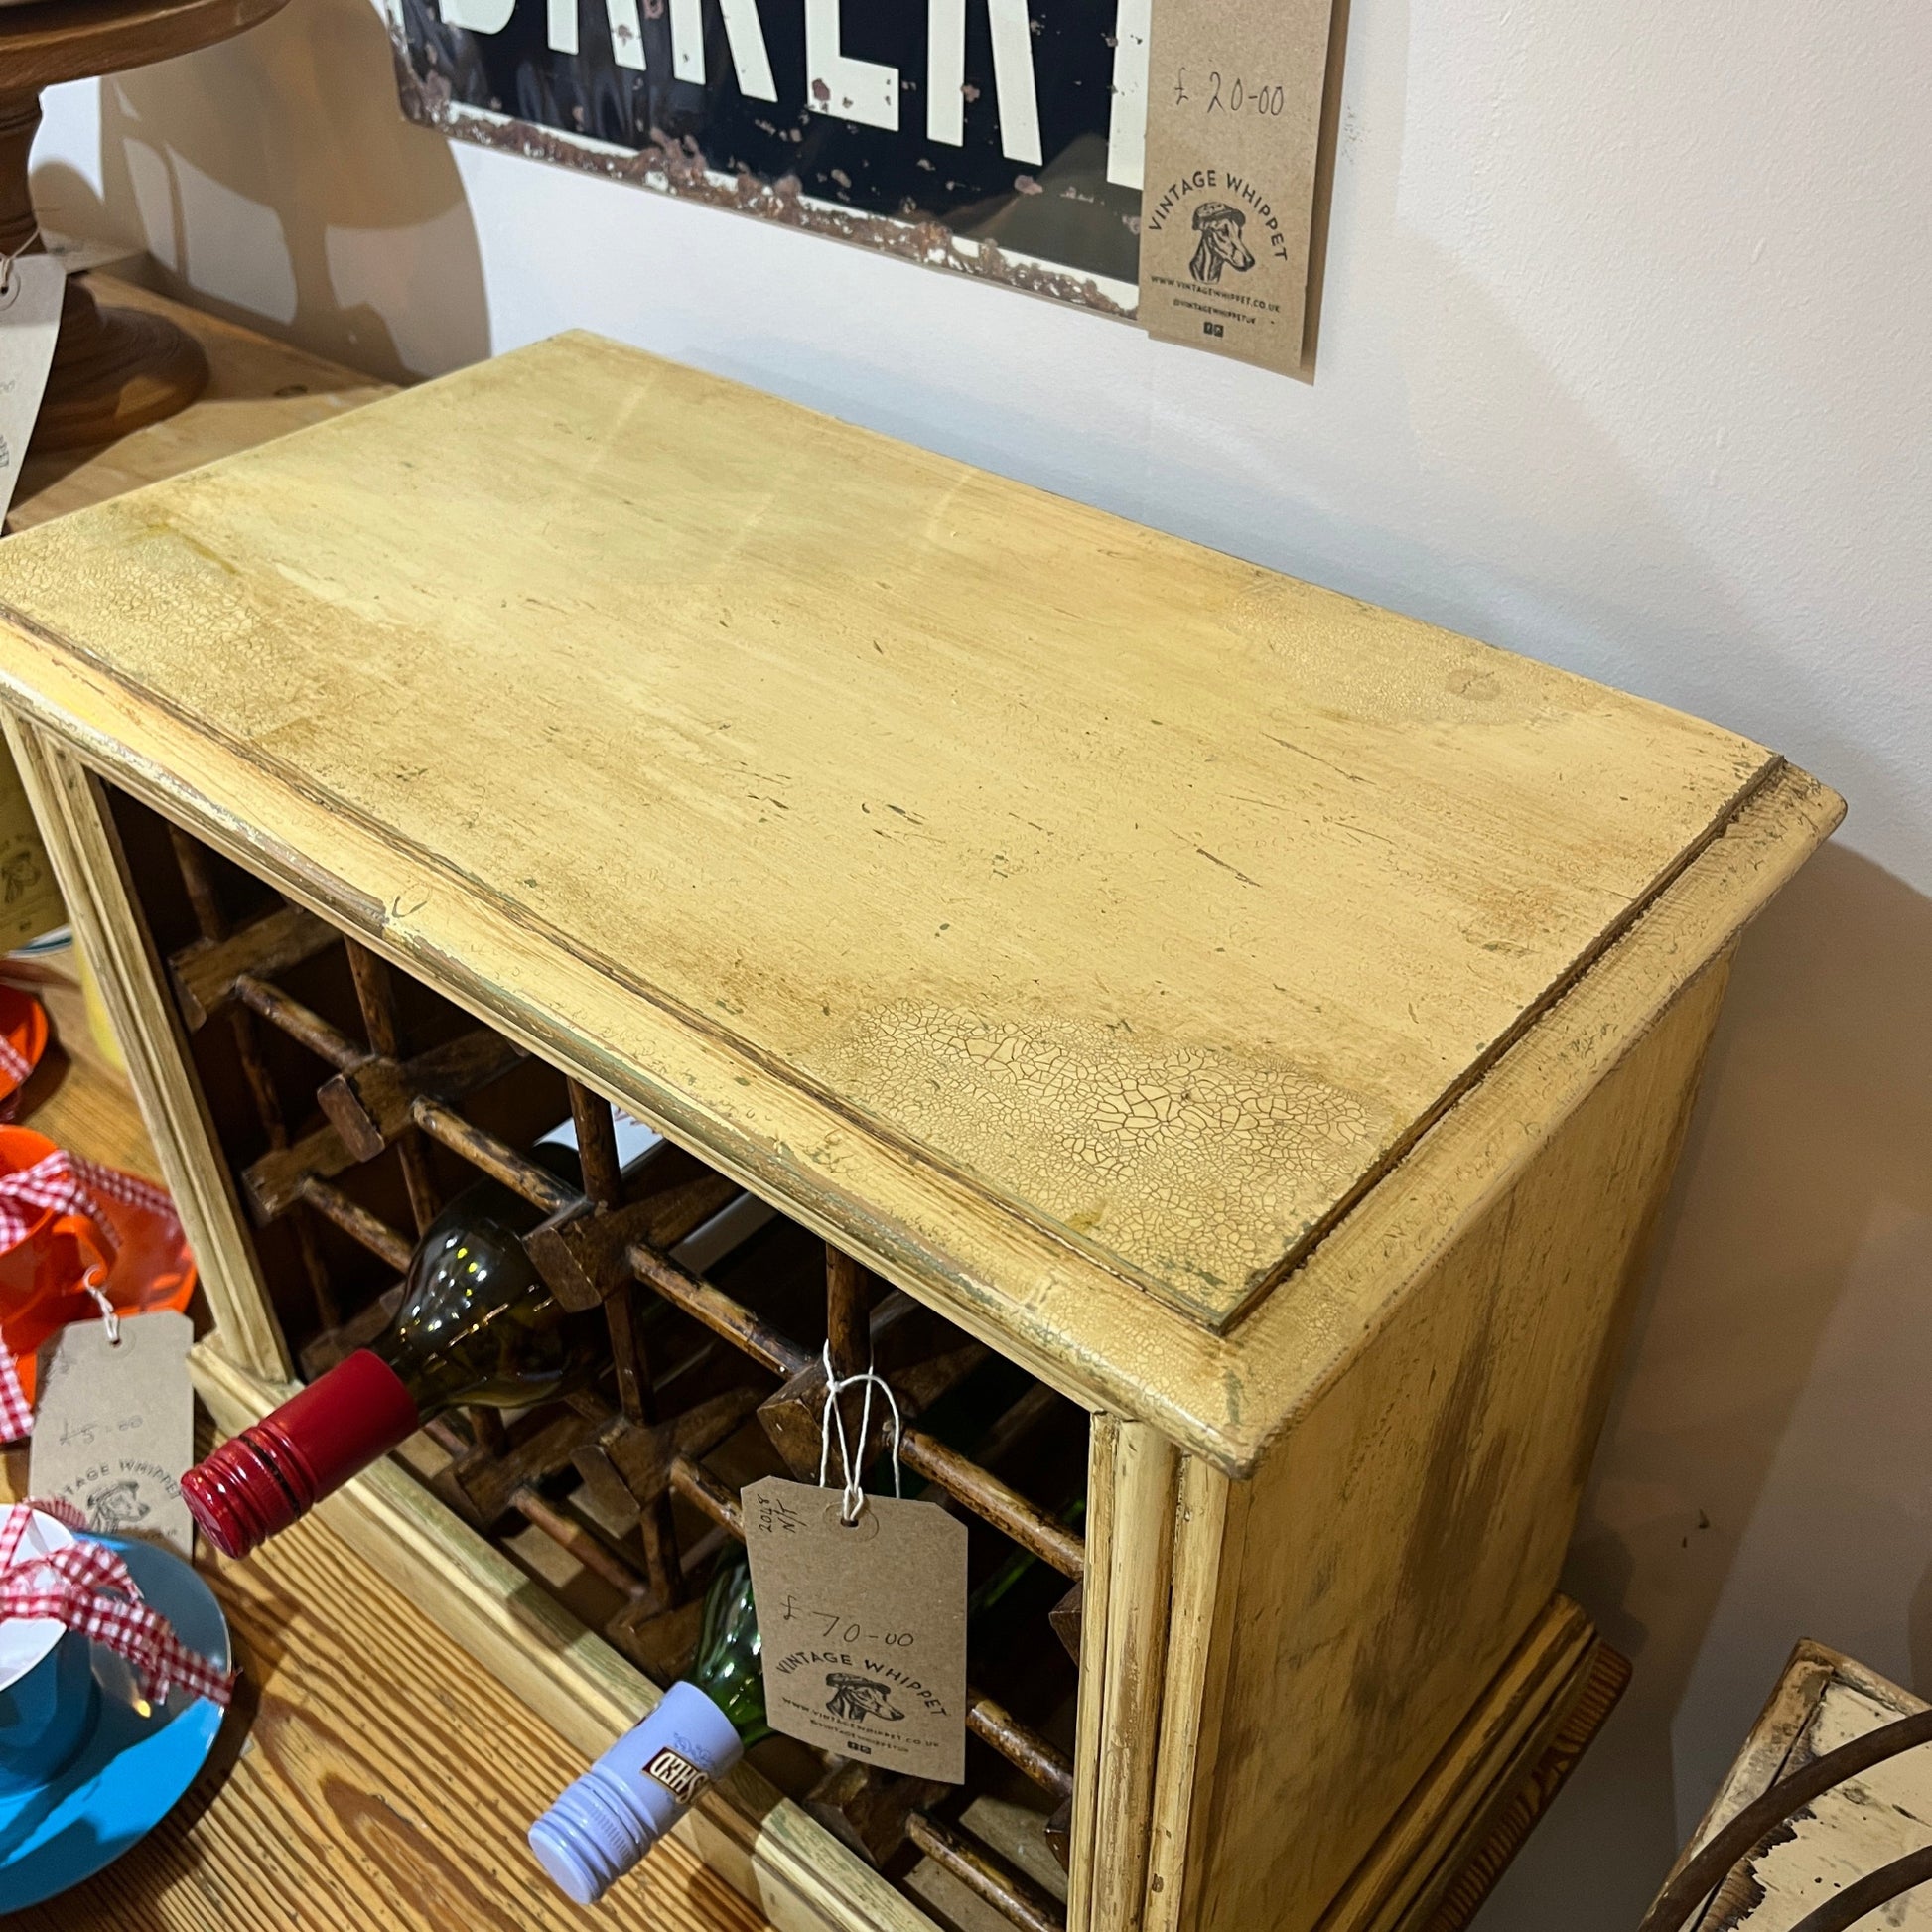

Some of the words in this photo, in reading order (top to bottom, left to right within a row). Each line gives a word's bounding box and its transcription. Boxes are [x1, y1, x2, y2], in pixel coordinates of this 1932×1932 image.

[1149, 169, 1217, 231] VINTAGE
[1226, 173, 1288, 261] WHIPPET
[776, 1651, 853, 1675] VINTAGE
[864, 1659, 948, 1718] WHIPPET
[649, 1752, 710, 1804] SHED
